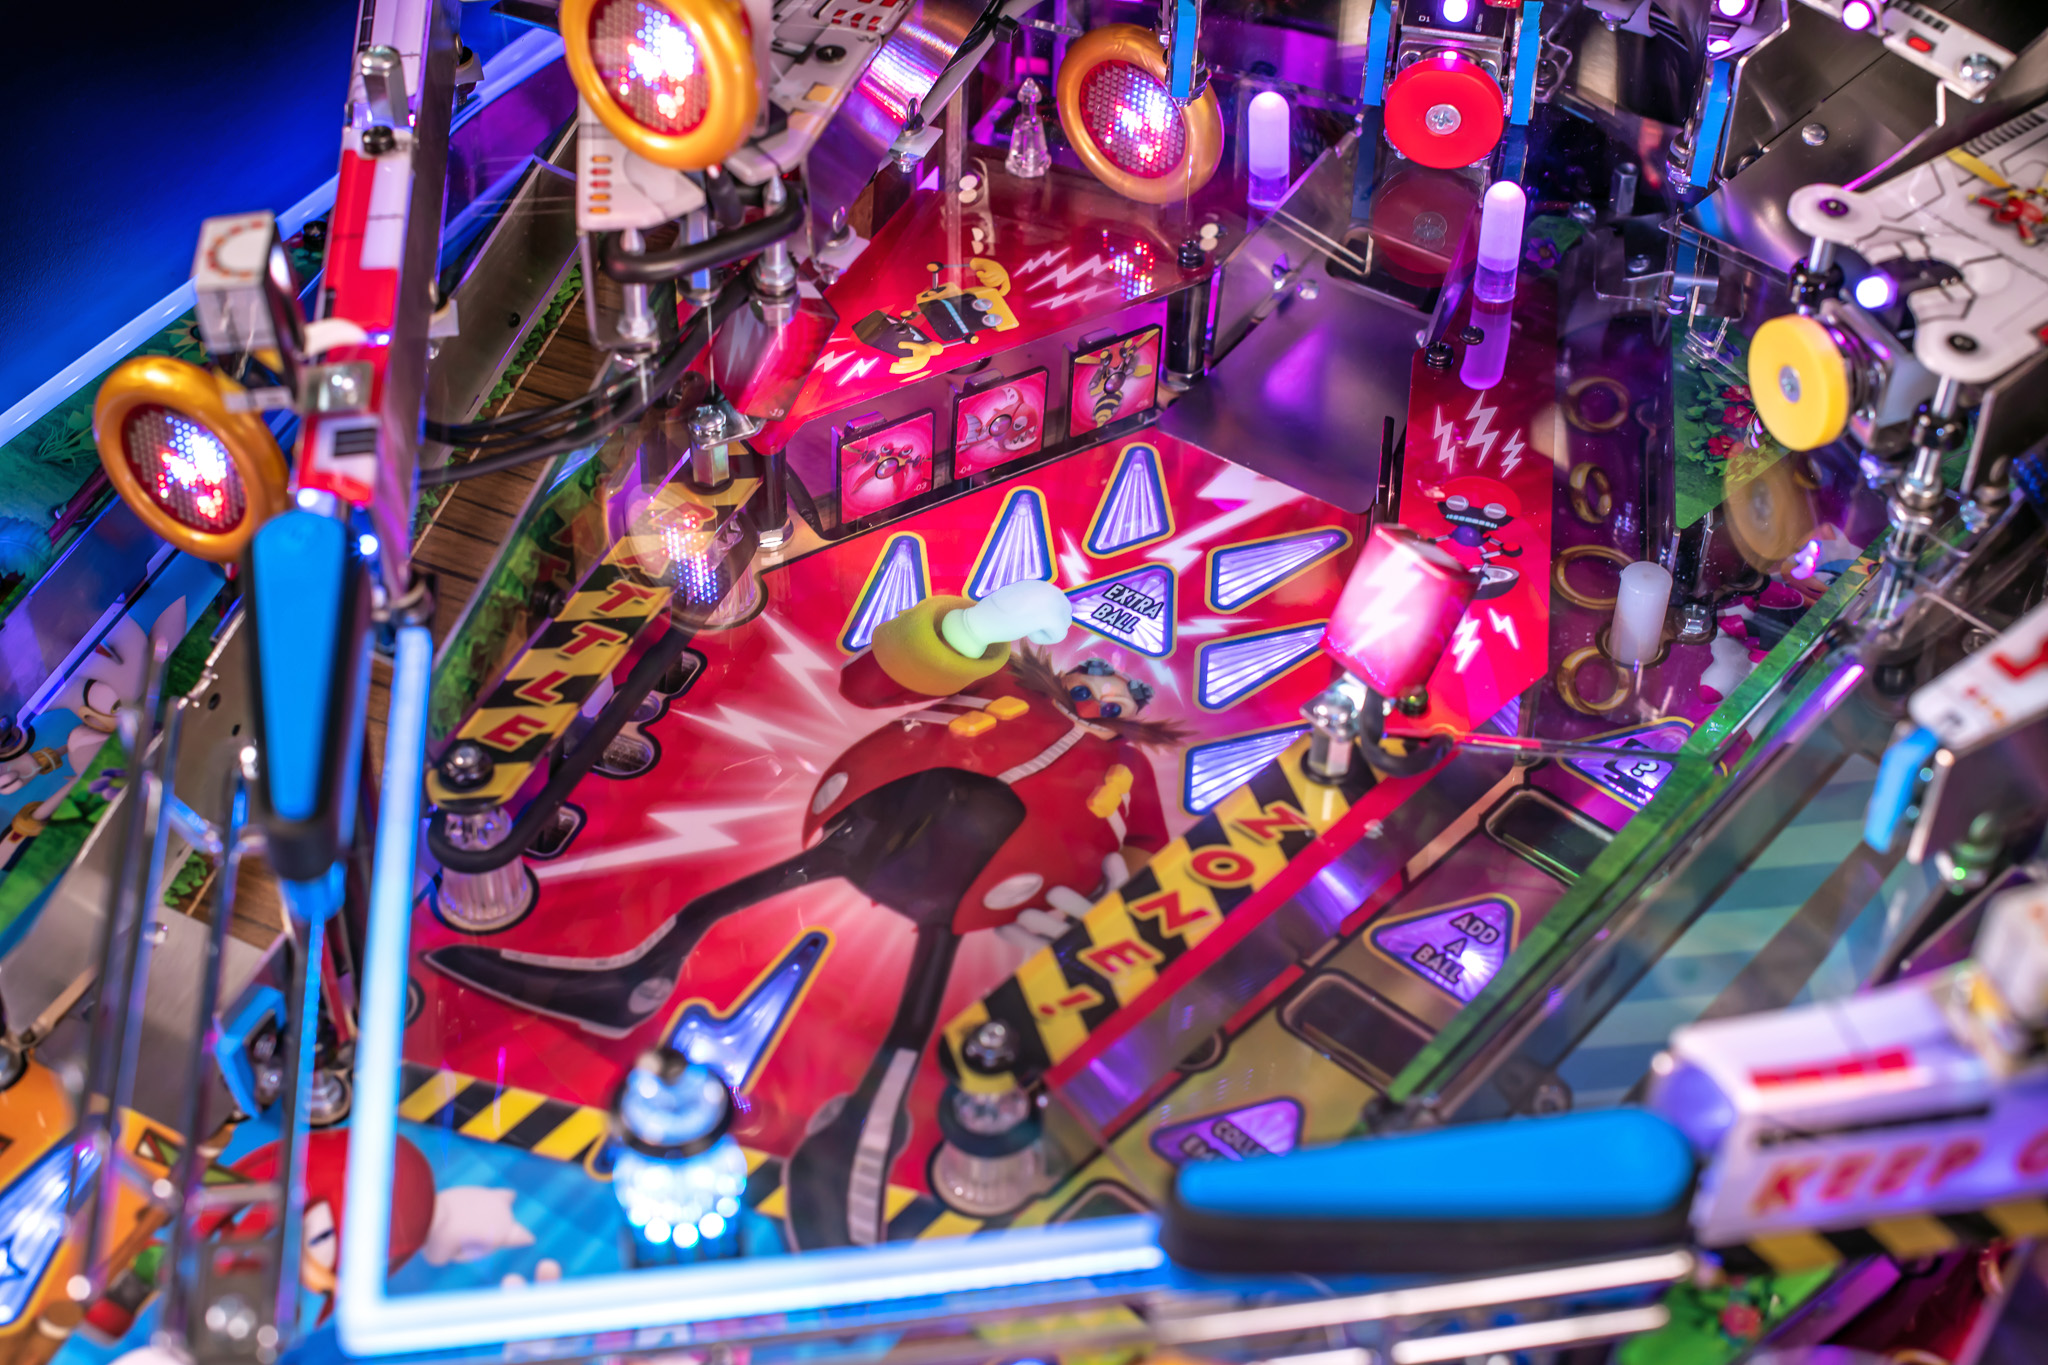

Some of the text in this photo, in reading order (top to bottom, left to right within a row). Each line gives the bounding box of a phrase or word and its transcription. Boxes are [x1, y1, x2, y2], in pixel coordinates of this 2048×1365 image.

[1091, 603, 1140, 634] BALL
[1102, 583, 1164, 620] EXTRA
[1449, 912, 1499, 945] ADD
[1412, 944, 1465, 984] BALL
[1444, 938, 1467, 957] A
[1753, 1137, 1980, 1216] KEEP
